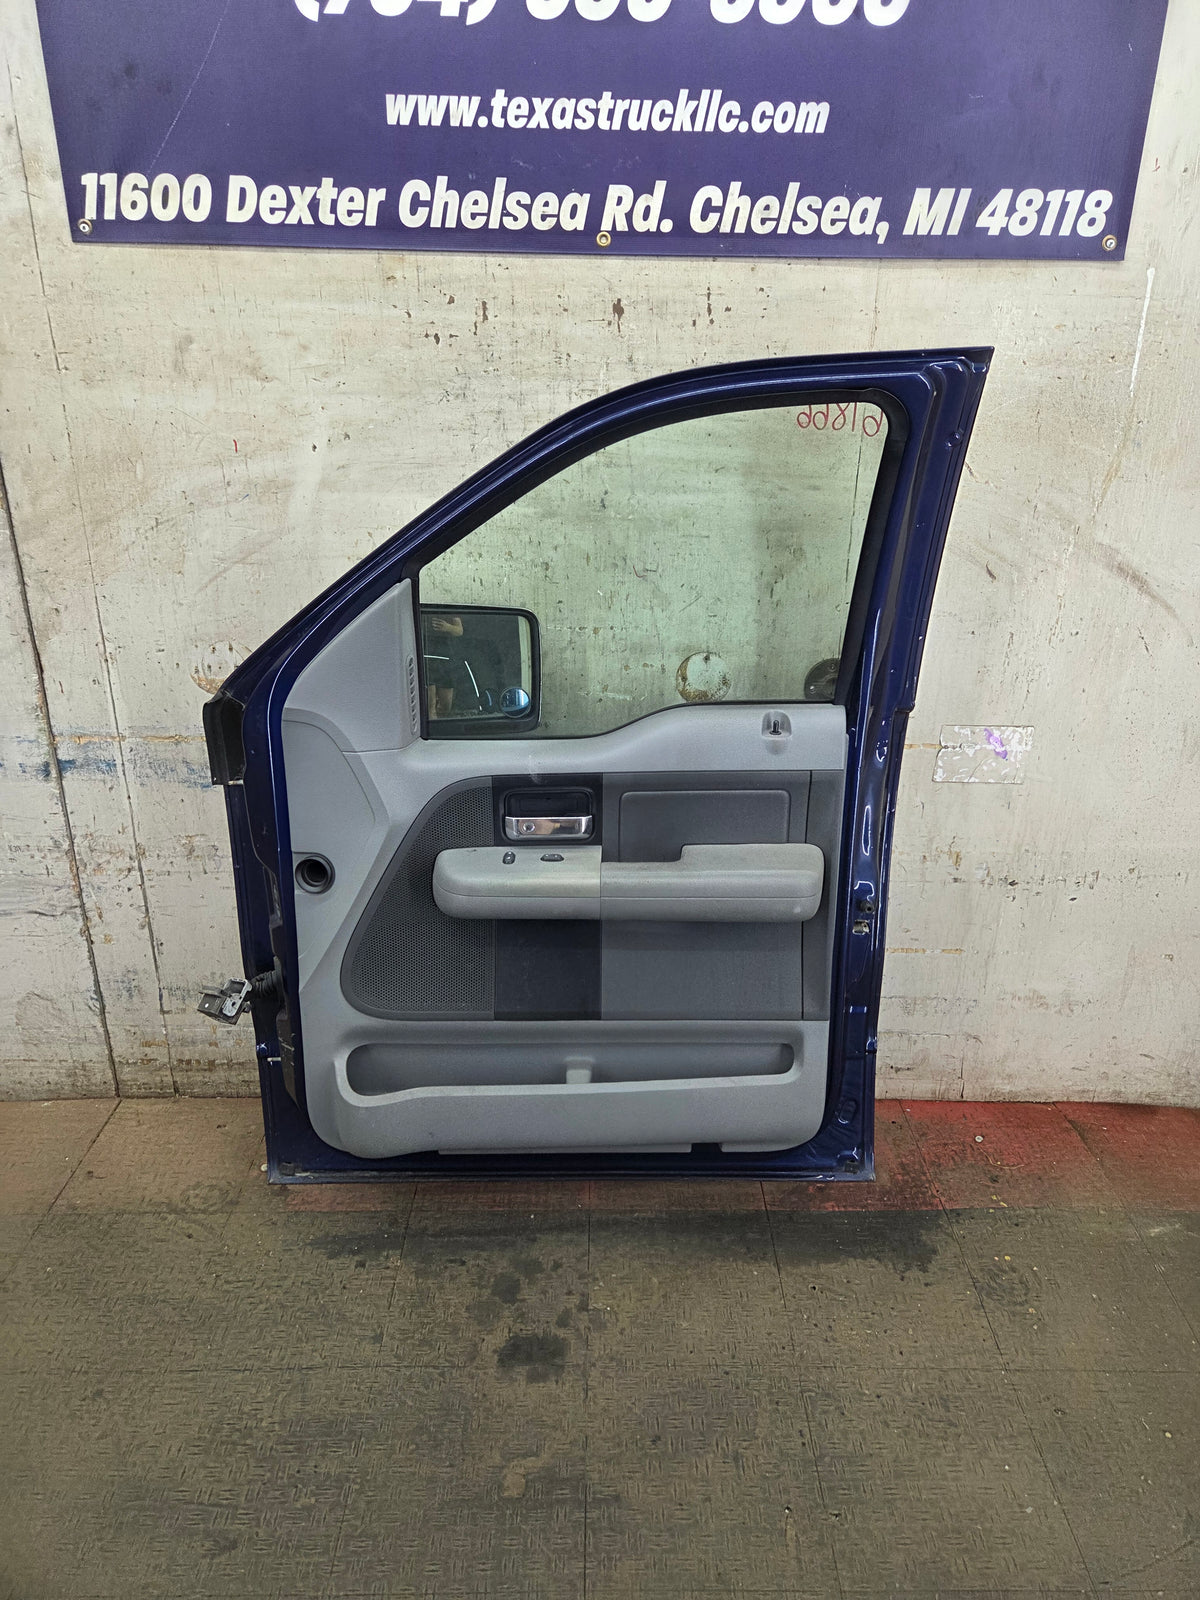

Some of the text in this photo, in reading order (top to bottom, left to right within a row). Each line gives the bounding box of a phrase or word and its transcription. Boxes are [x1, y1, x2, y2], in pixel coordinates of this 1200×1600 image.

[385, 88, 831, 134] www.texastruckllc.com
[80, 172, 1114, 245] 11600 Dexter Chelsea Rd. Chelsea, MI 48118
